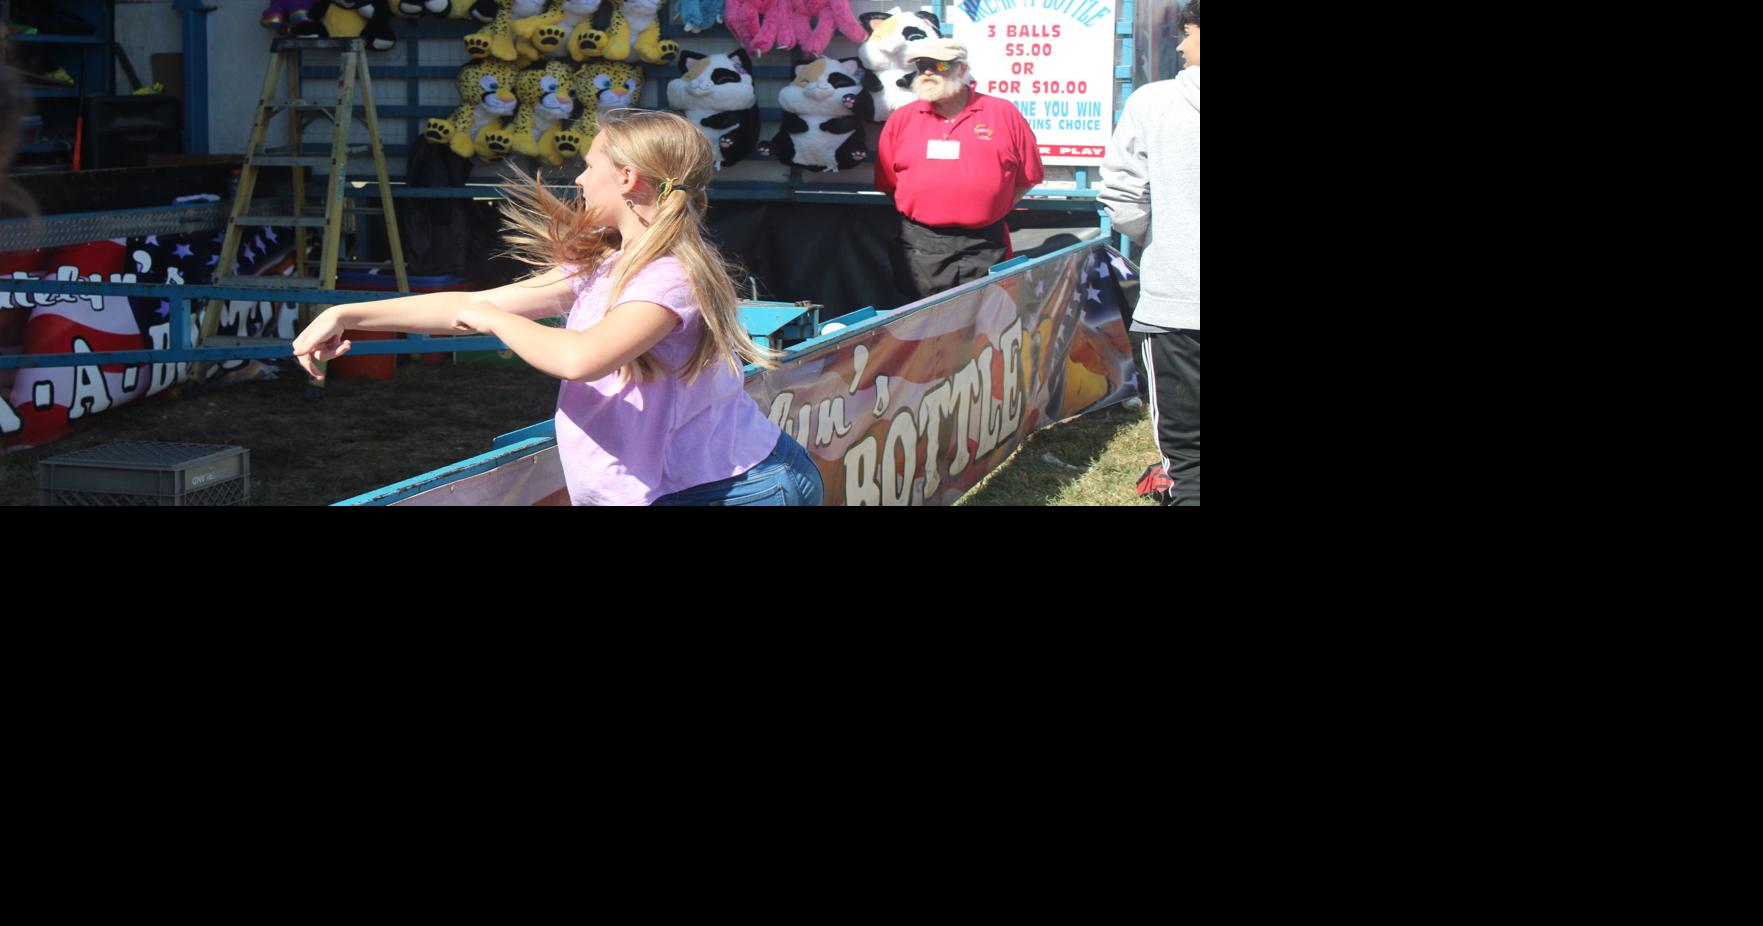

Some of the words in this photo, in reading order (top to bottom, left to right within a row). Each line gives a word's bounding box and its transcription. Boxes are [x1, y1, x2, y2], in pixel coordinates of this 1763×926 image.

[988, 25, 996, 37] 3
[1006, 25, 1061, 37] BALLS
[1006, 43, 1052, 56] $5.00
[1011, 62, 1034, 75] OR
[988, 80, 1021, 93] FOR
[1032, 80, 1087, 94] $10.00
[1045, 101, 1069, 117] YOU
[1077, 102, 1101, 117] WIN
[1028, 119, 1051, 130] INS
[1058, 120, 1100, 130] CHOICE
[1060, 147, 1103, 155] PLAY
[844, 317, 1022, 505] BOTTLE
